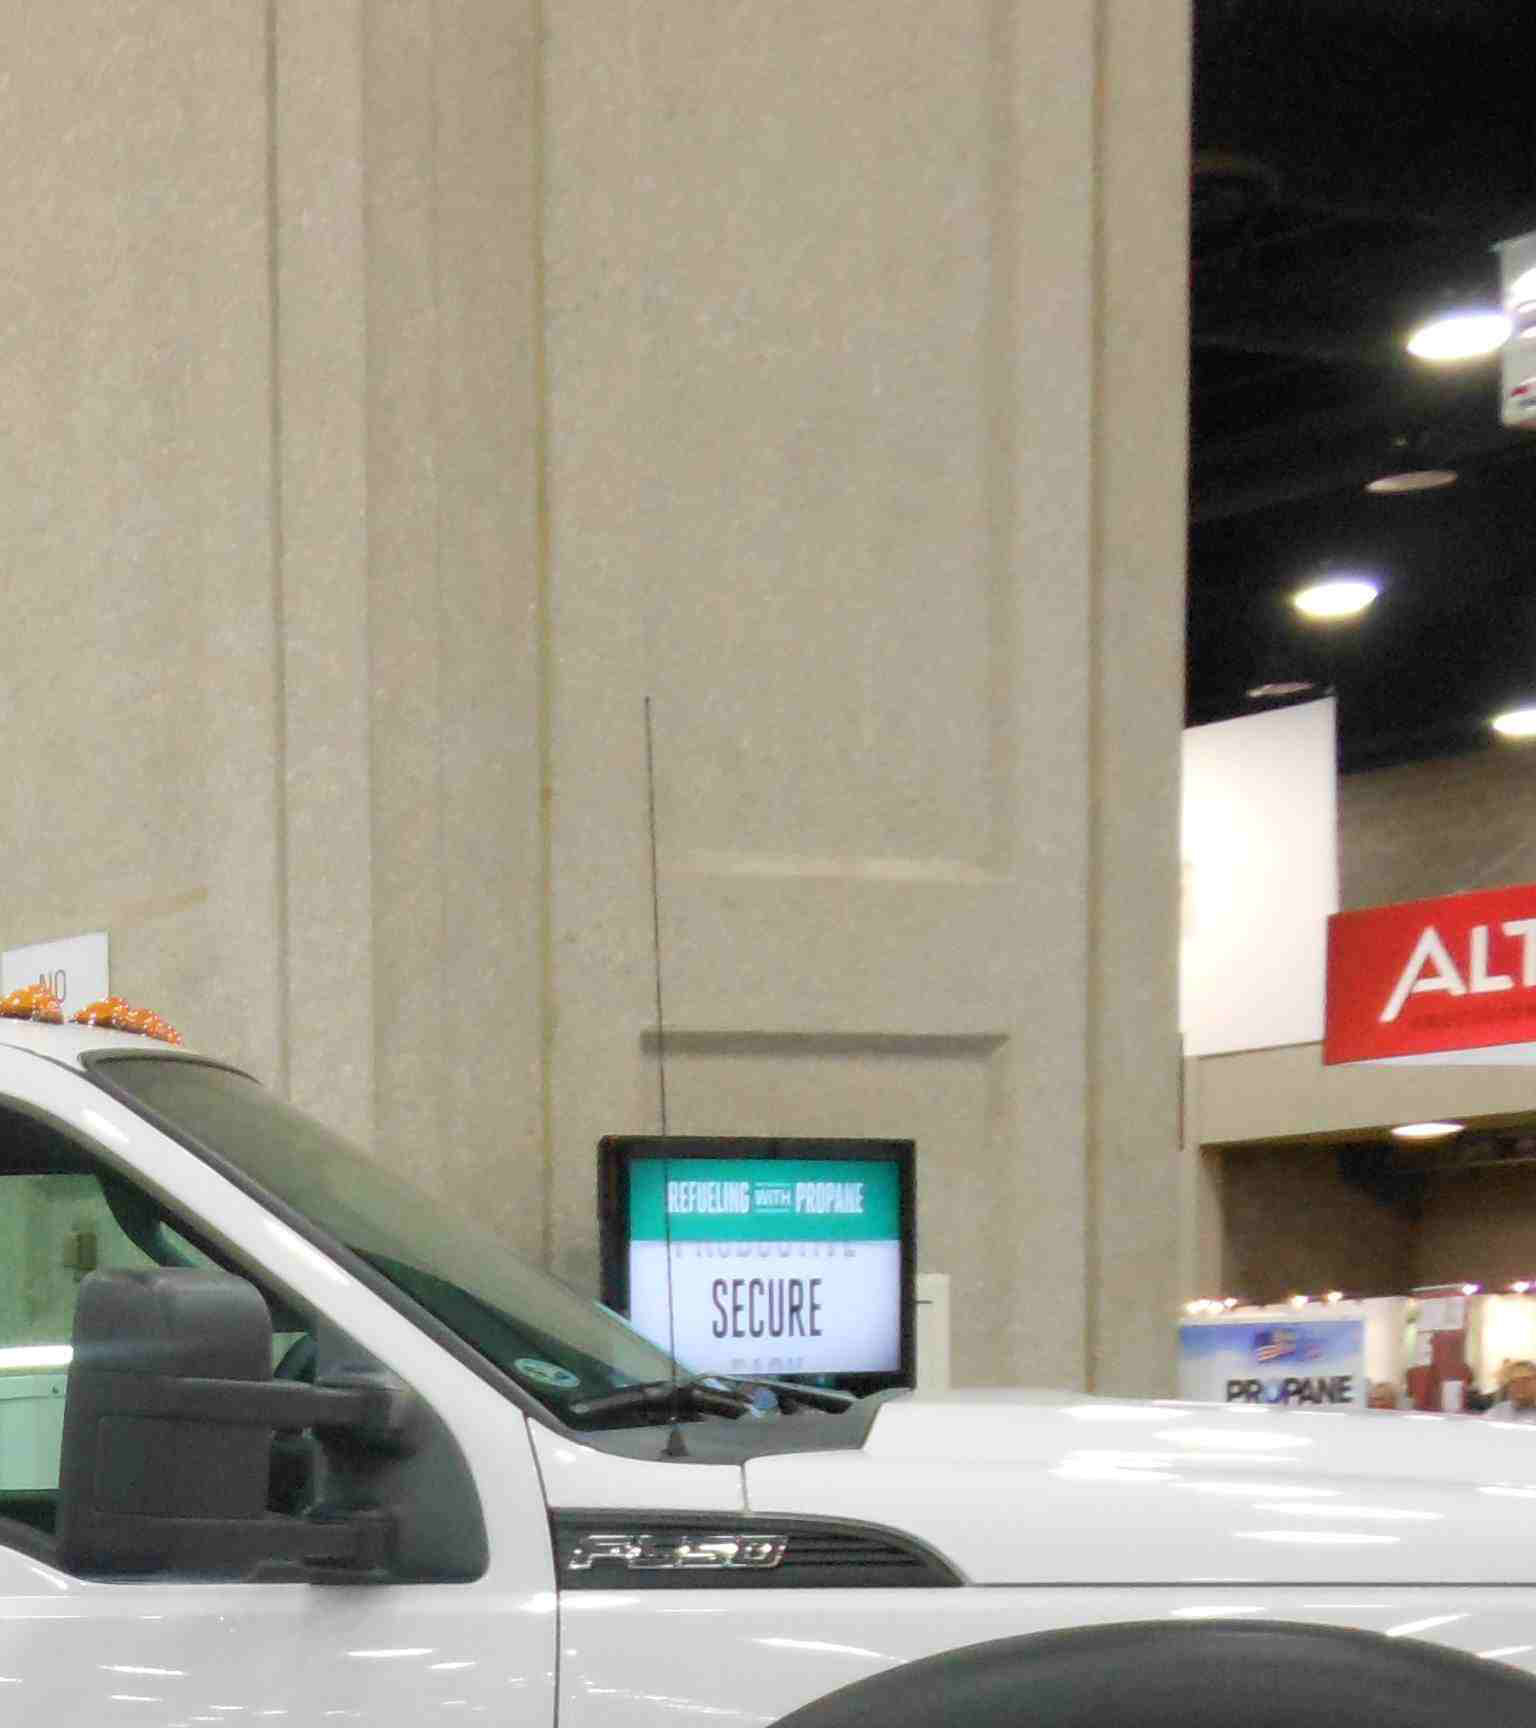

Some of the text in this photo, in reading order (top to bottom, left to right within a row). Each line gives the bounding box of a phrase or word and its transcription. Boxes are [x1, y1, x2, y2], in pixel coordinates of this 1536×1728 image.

[668, 1180, 751, 1214] REFUELING
[794, 1181, 864, 1214] PROPANE
[711, 1277, 823, 1339] SECURE
[1226, 1376, 1352, 1404] PROPANE
